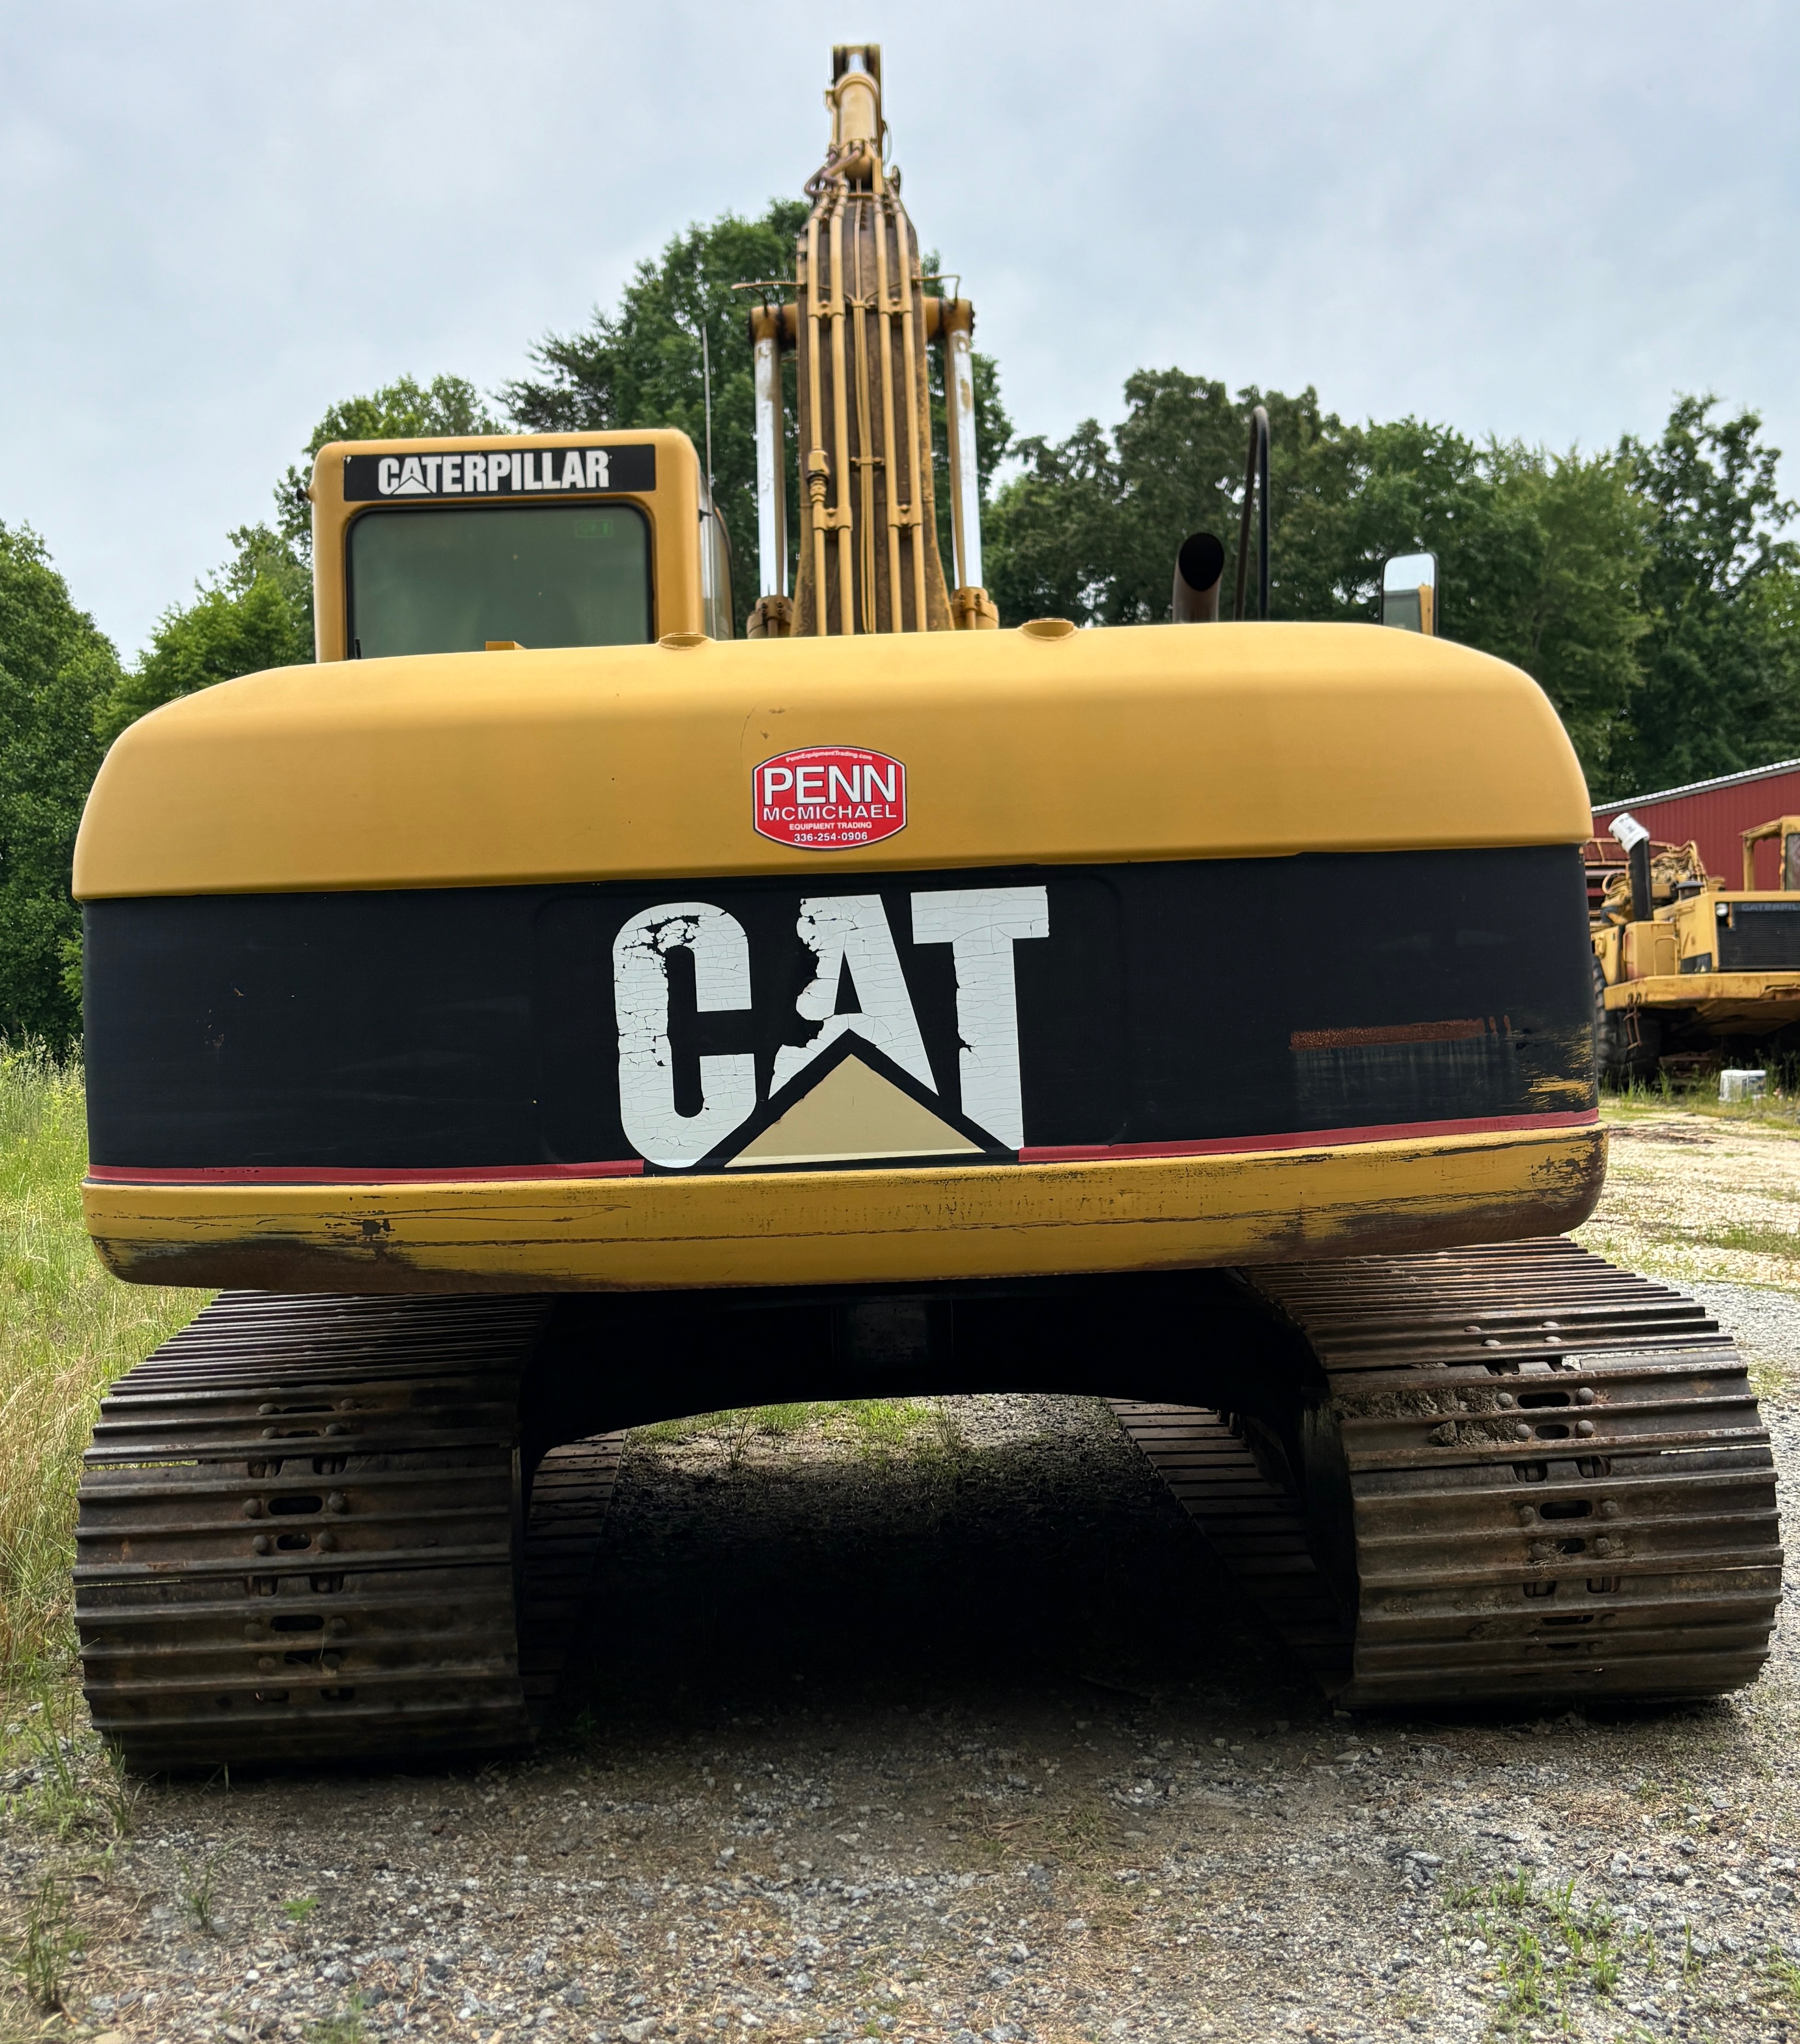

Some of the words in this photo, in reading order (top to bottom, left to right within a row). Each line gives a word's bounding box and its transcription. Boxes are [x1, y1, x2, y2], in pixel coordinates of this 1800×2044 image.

[378, 450, 610, 495] CATERPILLAR
[786, 750, 873, 763] PennEquipmentTrading.com
[763, 764, 896, 805] PENN
[763, 804, 897, 821] MCMICHAEL
[789, 822, 835, 831] EQUIPMENT
[837, 821, 872, 830] TRADING
[794, 832, 868, 842] 336-254-0906
[612, 886, 1049, 1168] CAT
